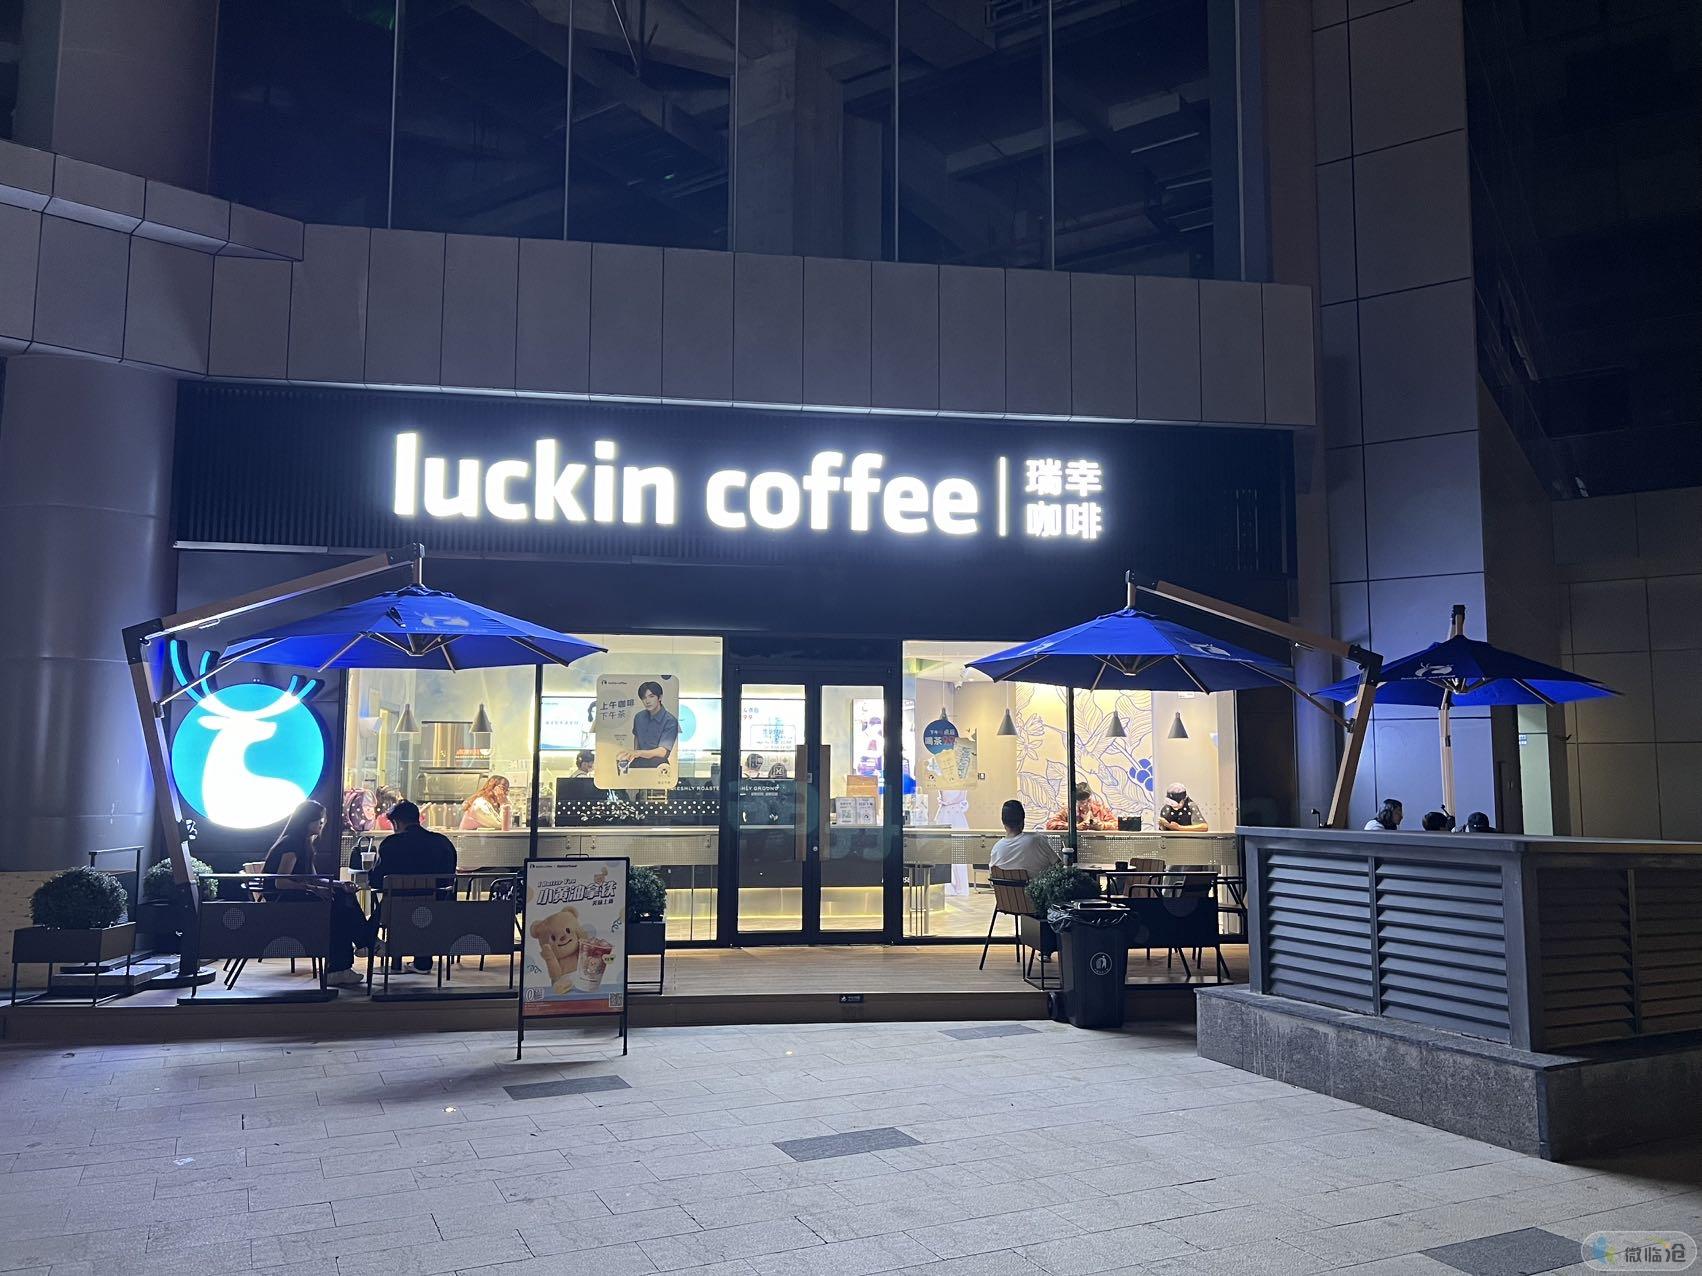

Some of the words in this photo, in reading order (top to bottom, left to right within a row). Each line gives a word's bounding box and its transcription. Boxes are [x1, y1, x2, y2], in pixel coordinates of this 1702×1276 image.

[393, 432, 676, 525] luckin
[706, 450, 979, 535] coffee
[1025, 457, 1103, 497] 瑞幸
[1025, 500, 1103, 540] 咖啡
[600, 699, 635, 711] 上午咖啡
[600, 709, 626, 721] 下午茶
[536, 880, 617, 905] 小黄油拿铁
